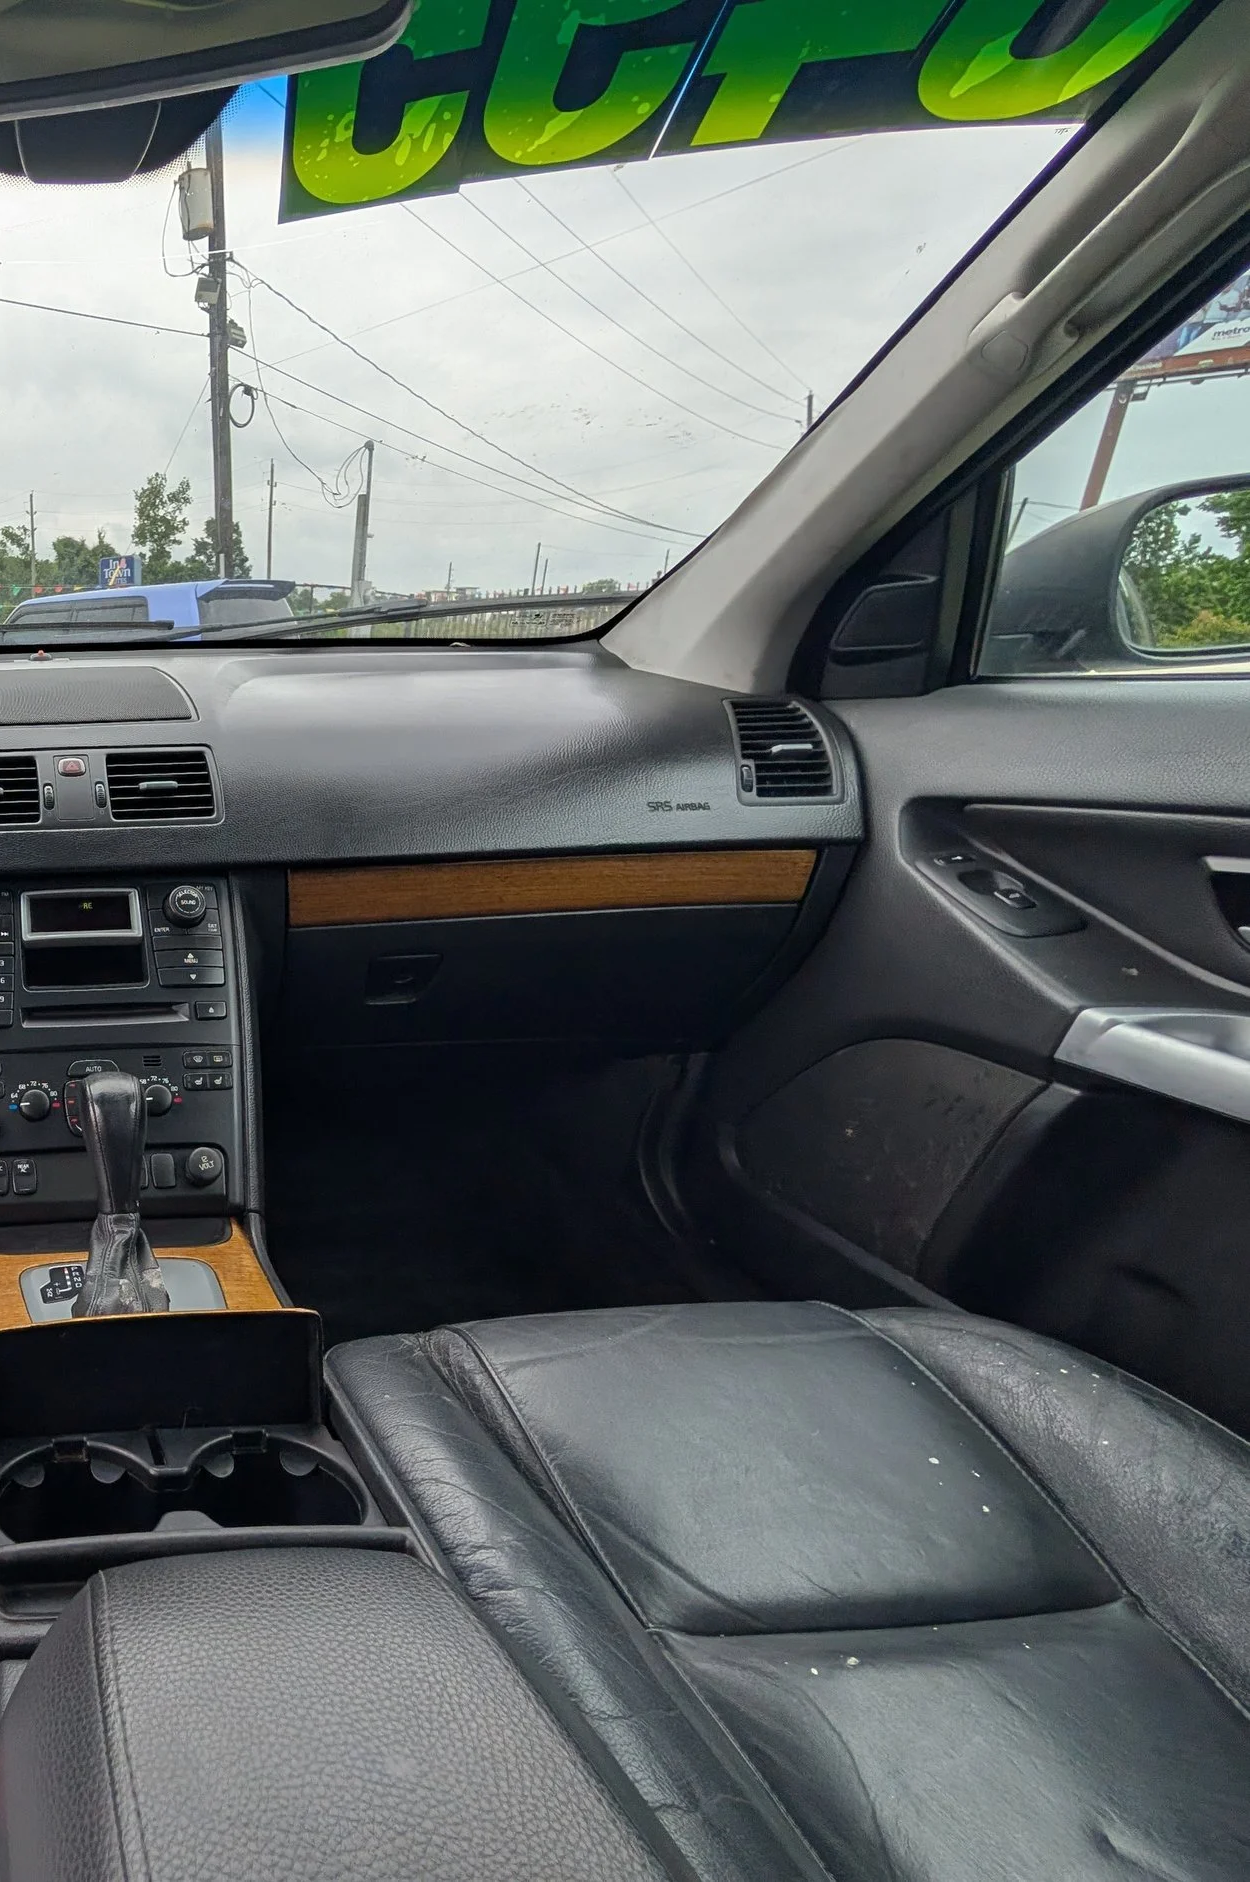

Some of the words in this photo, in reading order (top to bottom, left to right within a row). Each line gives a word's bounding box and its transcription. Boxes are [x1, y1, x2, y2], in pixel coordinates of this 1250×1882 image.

[647, 801, 673, 812] SRS
[676, 802, 711, 811] AIRBAG
[0, 959, 5, 967] 3
[0, 976, 5, 984] 6
[0, 995, 5, 1003] 9
[85, 1065, 102, 1073] AUTO
[198, 1160, 215, 1171] VOLT
